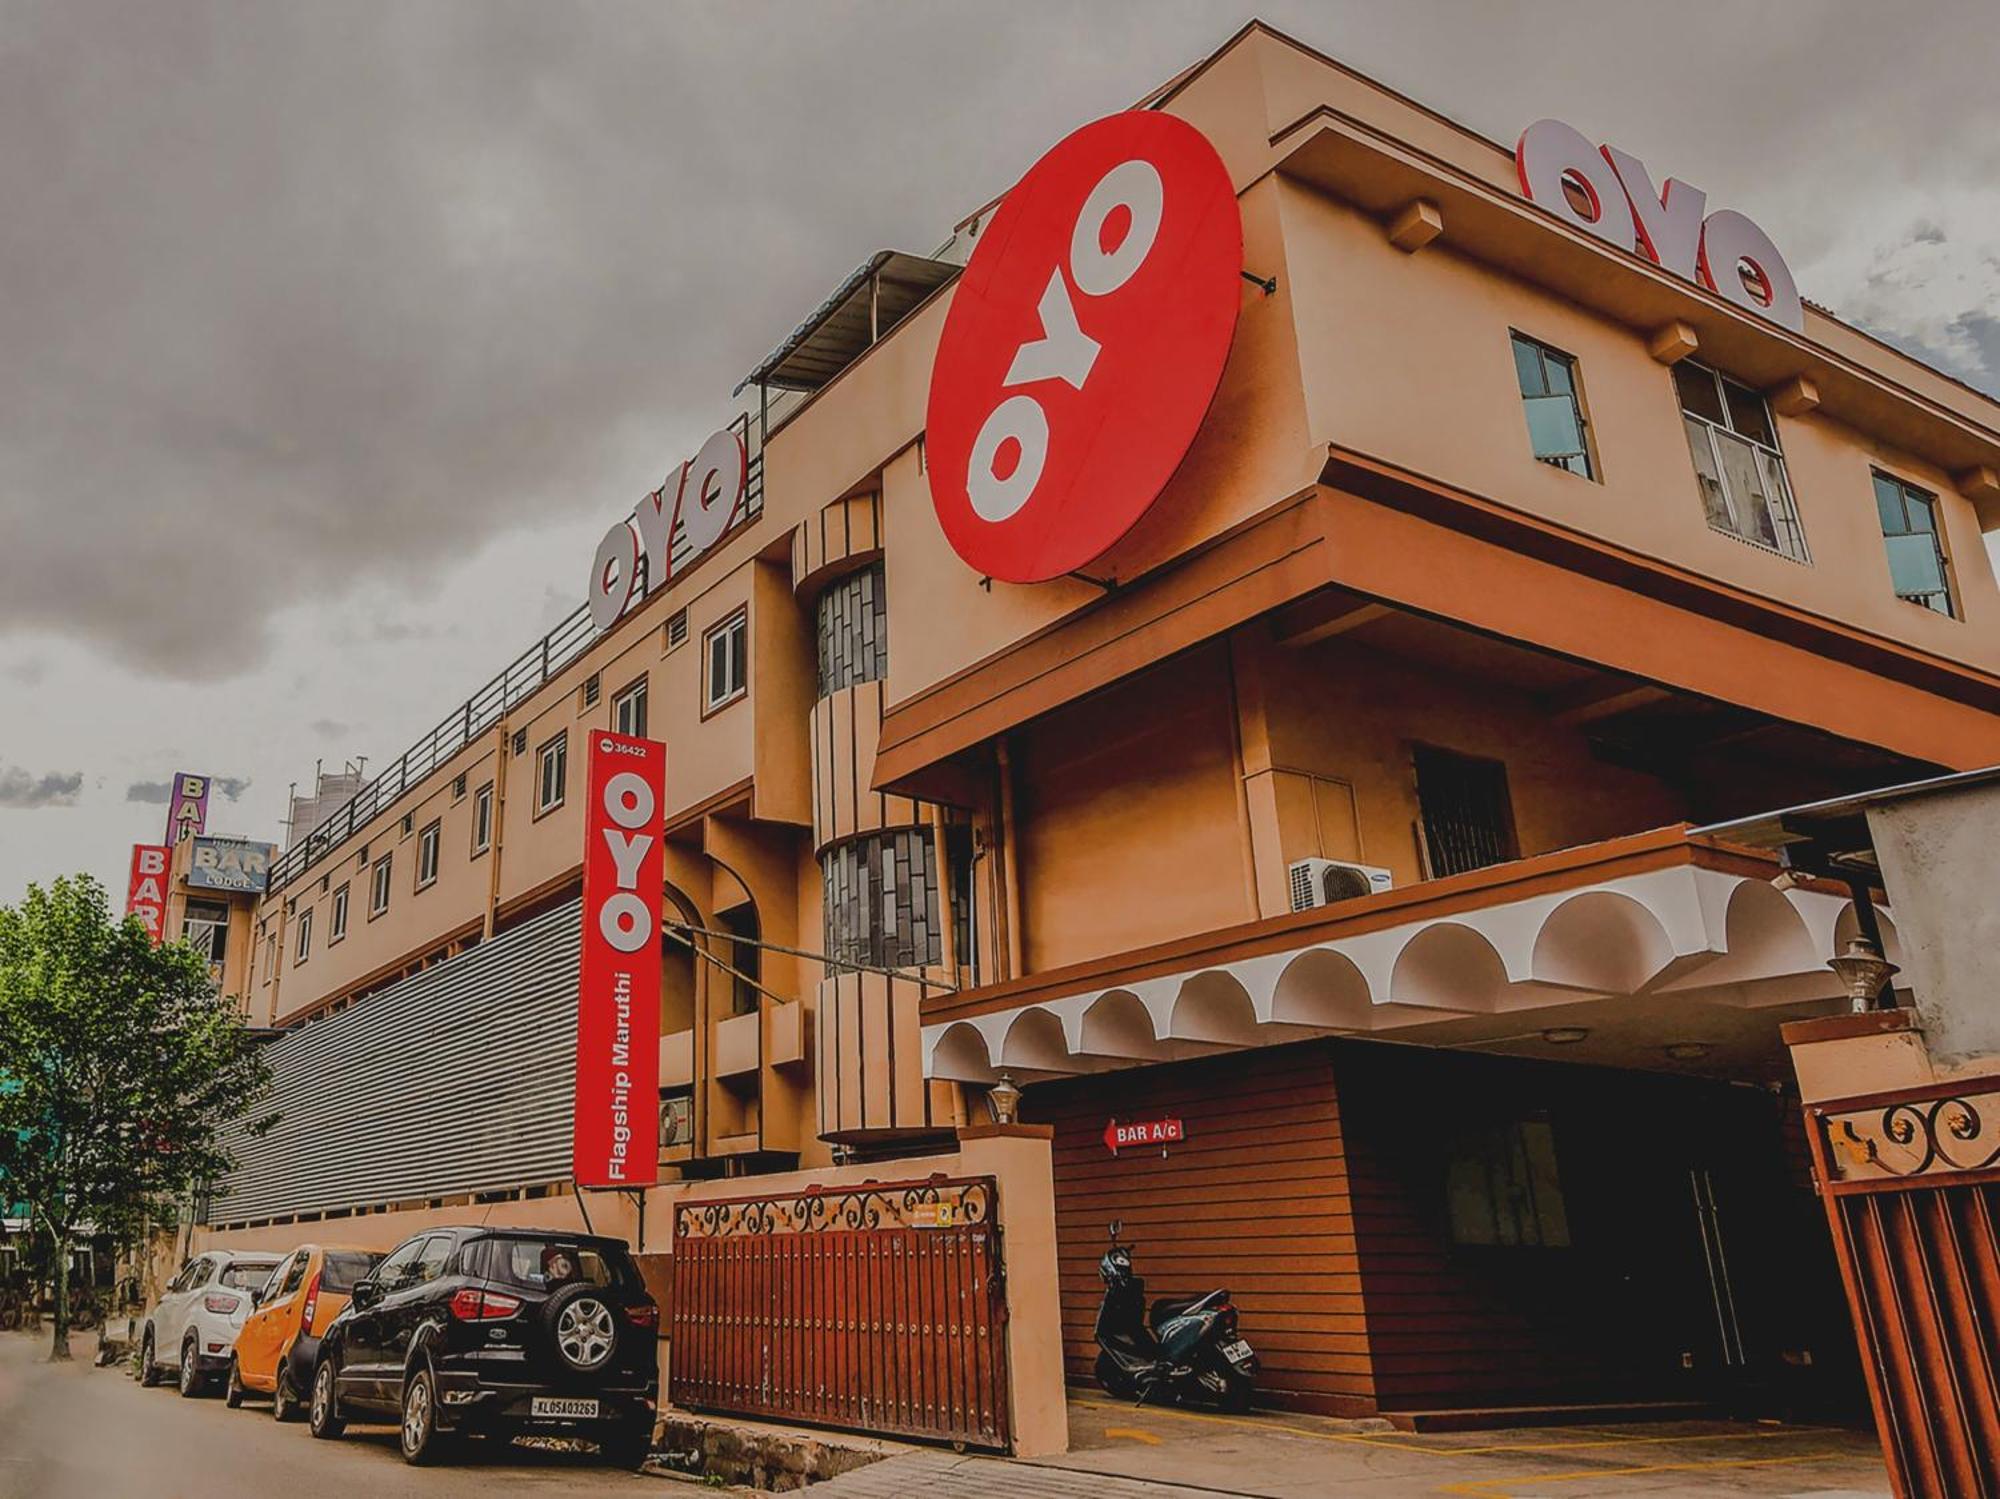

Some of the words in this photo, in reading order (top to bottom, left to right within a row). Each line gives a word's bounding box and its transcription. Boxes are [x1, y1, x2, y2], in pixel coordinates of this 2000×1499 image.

[1516, 118, 1803, 333] OYO
[967, 160, 1164, 522] OYO
[589, 429, 746, 630] OYO
[195, 847, 266, 875] BAR
[600, 772, 654, 952] OYO
[612, 972, 632, 1067] Maruthi
[608, 1072, 632, 1180] Flagship
[1117, 1126, 1148, 1142] BAR
